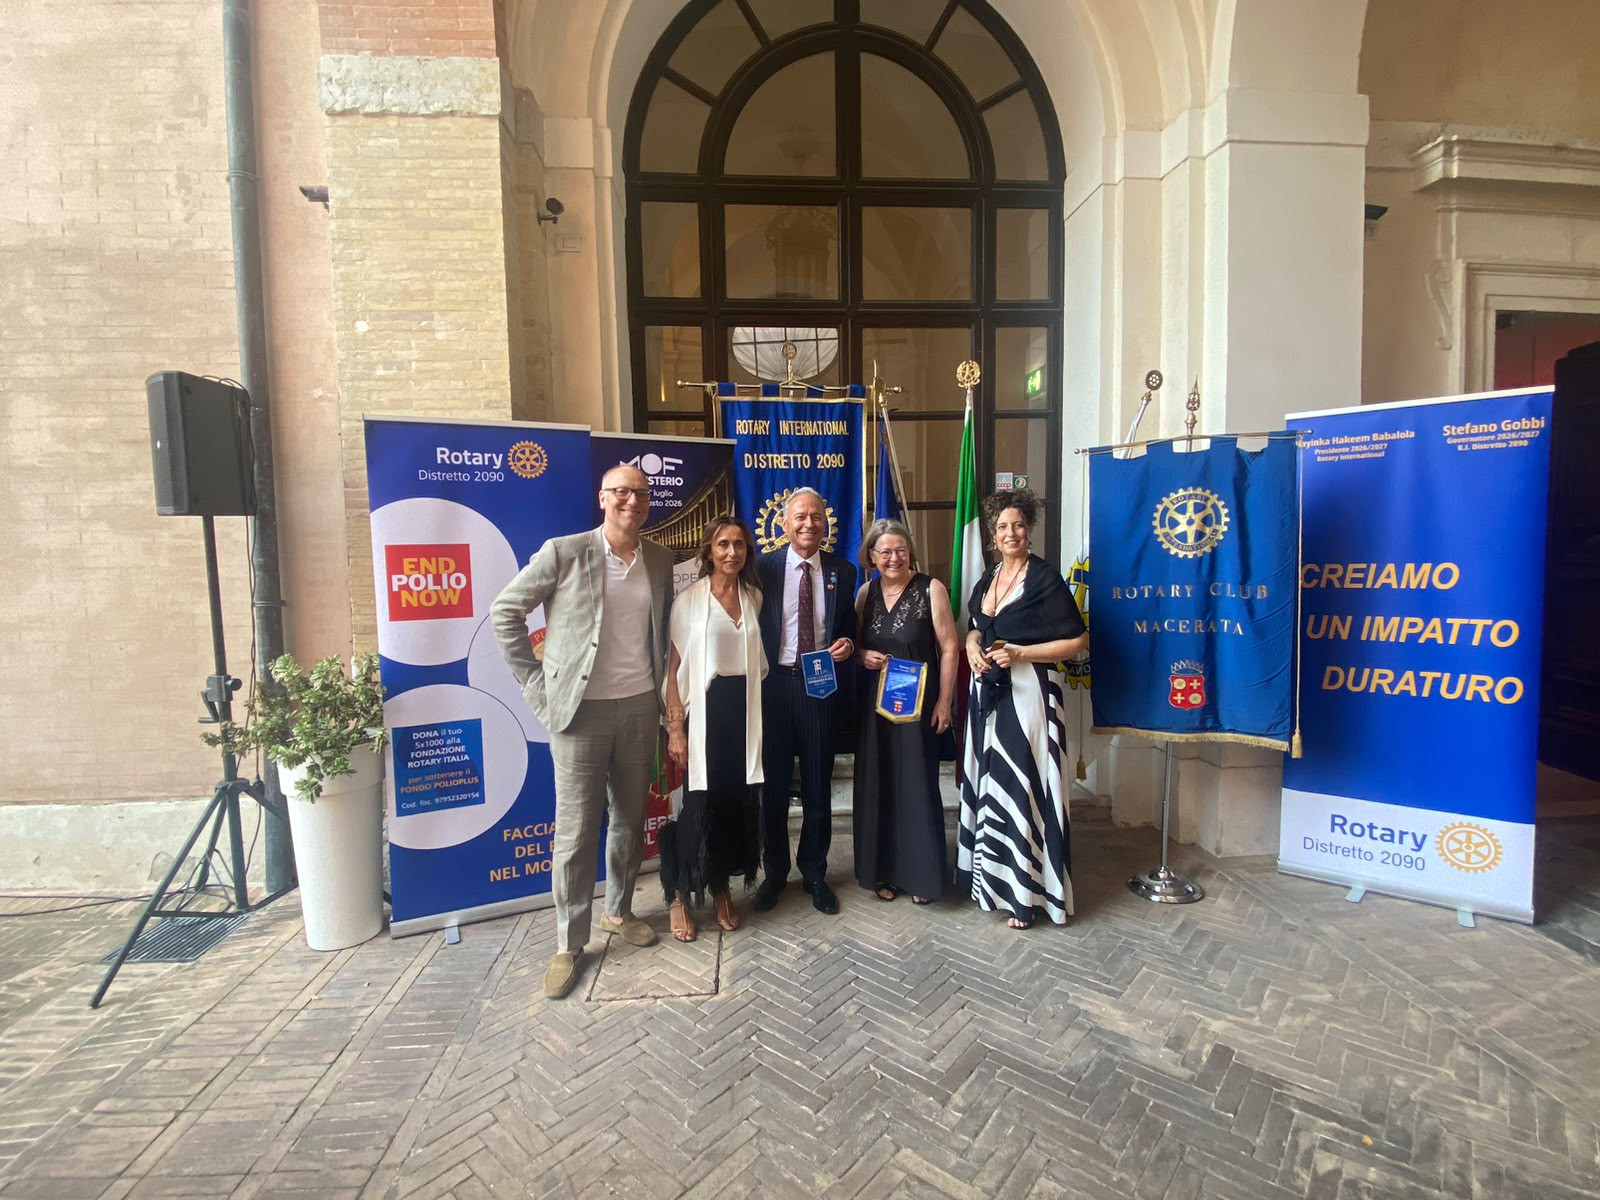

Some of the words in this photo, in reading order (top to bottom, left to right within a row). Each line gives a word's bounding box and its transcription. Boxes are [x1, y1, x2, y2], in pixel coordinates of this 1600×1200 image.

[736, 419, 770, 435] ROTARY
[779, 420, 849, 436] INTERNATIONAL
[1442, 422, 1497, 436] Stefano
[1501, 417, 1545, 431] Gobbi
[1332, 434, 1370, 445] Hakeem
[1372, 430, 1415, 441] Babalola
[1314, 446, 1350, 455] Presidente
[1351, 443, 1388, 452] 2026/2027
[1317, 454, 1338, 462] Rotary
[1340, 451, 1385, 460] International
[436, 447, 503, 469] Rotary
[744, 453, 810, 469] DISTRETTO
[817, 453, 844, 469] 2090
[418, 469, 471, 482] Distretto
[474, 471, 504, 482] 2090
[646, 476, 684, 486] STERIO
[653, 489, 673, 498] luglio
[403, 557, 456, 575] END
[392, 573, 467, 591] POLIO
[673, 573, 697, 583] OPE
[1301, 562, 1460, 589] CREIAMO
[401, 589, 460, 608] NOW
[1112, 584, 1193, 599] ROTARY
[1209, 582, 1268, 599] CLUB
[1134, 619, 1244, 636] MACERATA
[1306, 614, 1352, 640] UN
[1361, 616, 1519, 647] IMPATTO
[1322, 666, 1524, 704] DURATURO
[412, 730, 439, 740] DONA
[441, 728, 446, 736] il
[411, 745, 466, 759] FONDAZIONE
[415, 738, 444, 749] 5x1000
[408, 758, 441, 768] ROTARY
[444, 754, 470, 763] ITALIA
[401, 784, 432, 794] FONDO
[434, 776, 478, 789] POLIOPLUS
[408, 776, 422, 785] per
[425, 769, 463, 780] sostenere
[503, 822, 556, 842] FACCIA
[1330, 814, 1427, 852] Rotary
[515, 842, 544, 859] DEL
[1303, 836, 1373, 862] Distretto
[1380, 852, 1426, 871] 2090
[490, 867, 520, 882] NEL
[525, 860, 553, 876] MO
